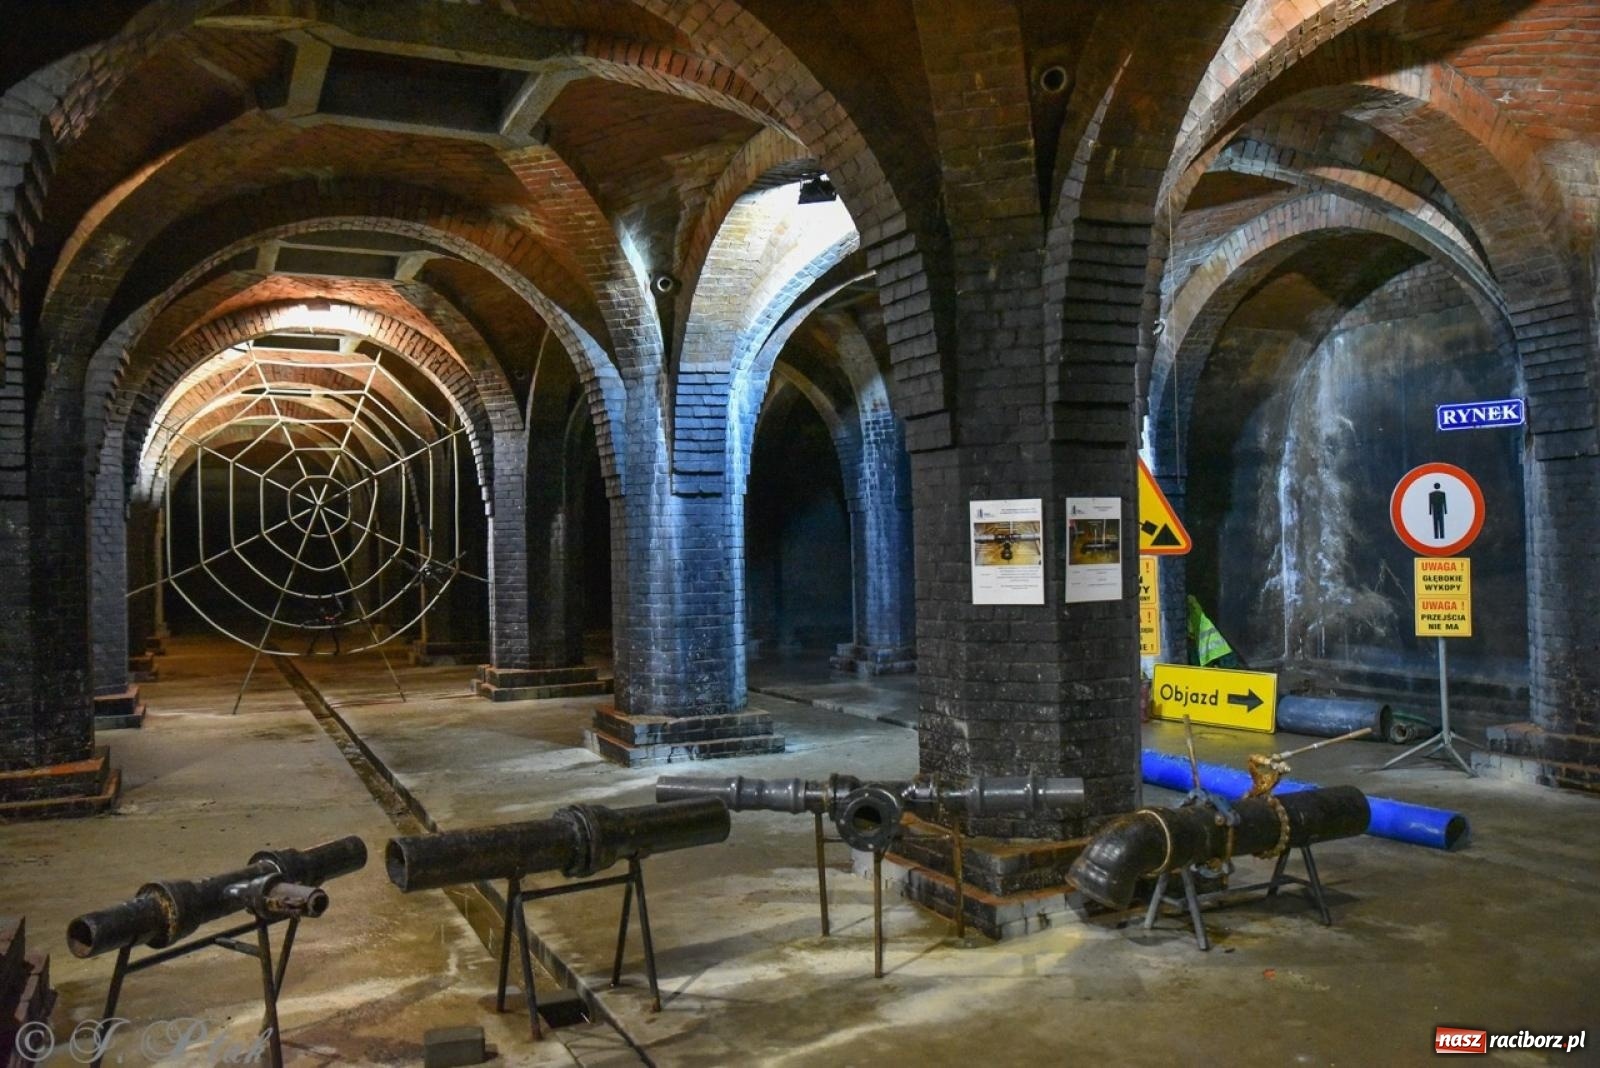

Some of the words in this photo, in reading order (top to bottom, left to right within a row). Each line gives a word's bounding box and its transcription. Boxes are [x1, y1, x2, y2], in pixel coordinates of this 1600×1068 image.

[1443, 405, 1519, 425] RYNEK
[1421, 562, 1457, 571] UWAGA
[1422, 574, 1463, 583] GŁĘBOKIE
[1422, 601, 1457, 610] UWAGA
[1421, 613, 1466, 621] PRZEJŚCIA
[1160, 683, 1219, 707] Objazd
